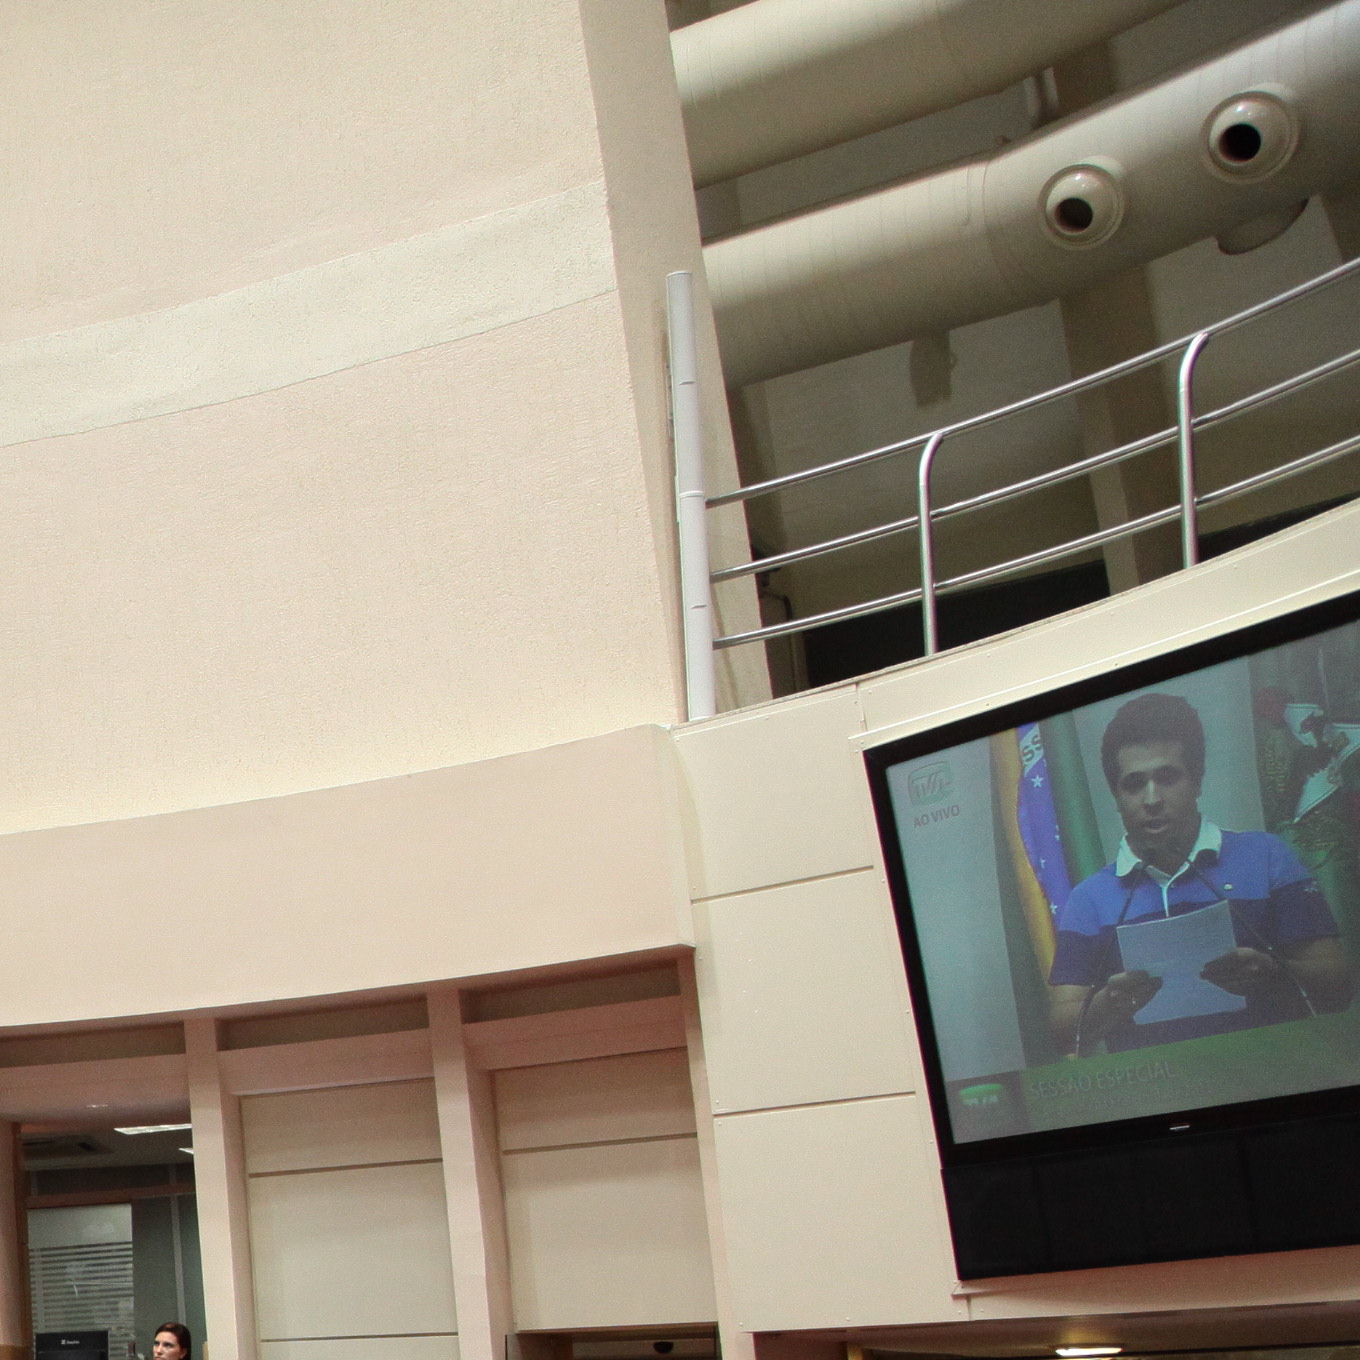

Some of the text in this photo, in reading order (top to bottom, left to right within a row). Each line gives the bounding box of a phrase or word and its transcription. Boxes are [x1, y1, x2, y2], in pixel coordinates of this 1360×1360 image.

[913, 804, 961, 829] AO VIVO
[1096, 1061, 1177, 1090] ESPECIAL
